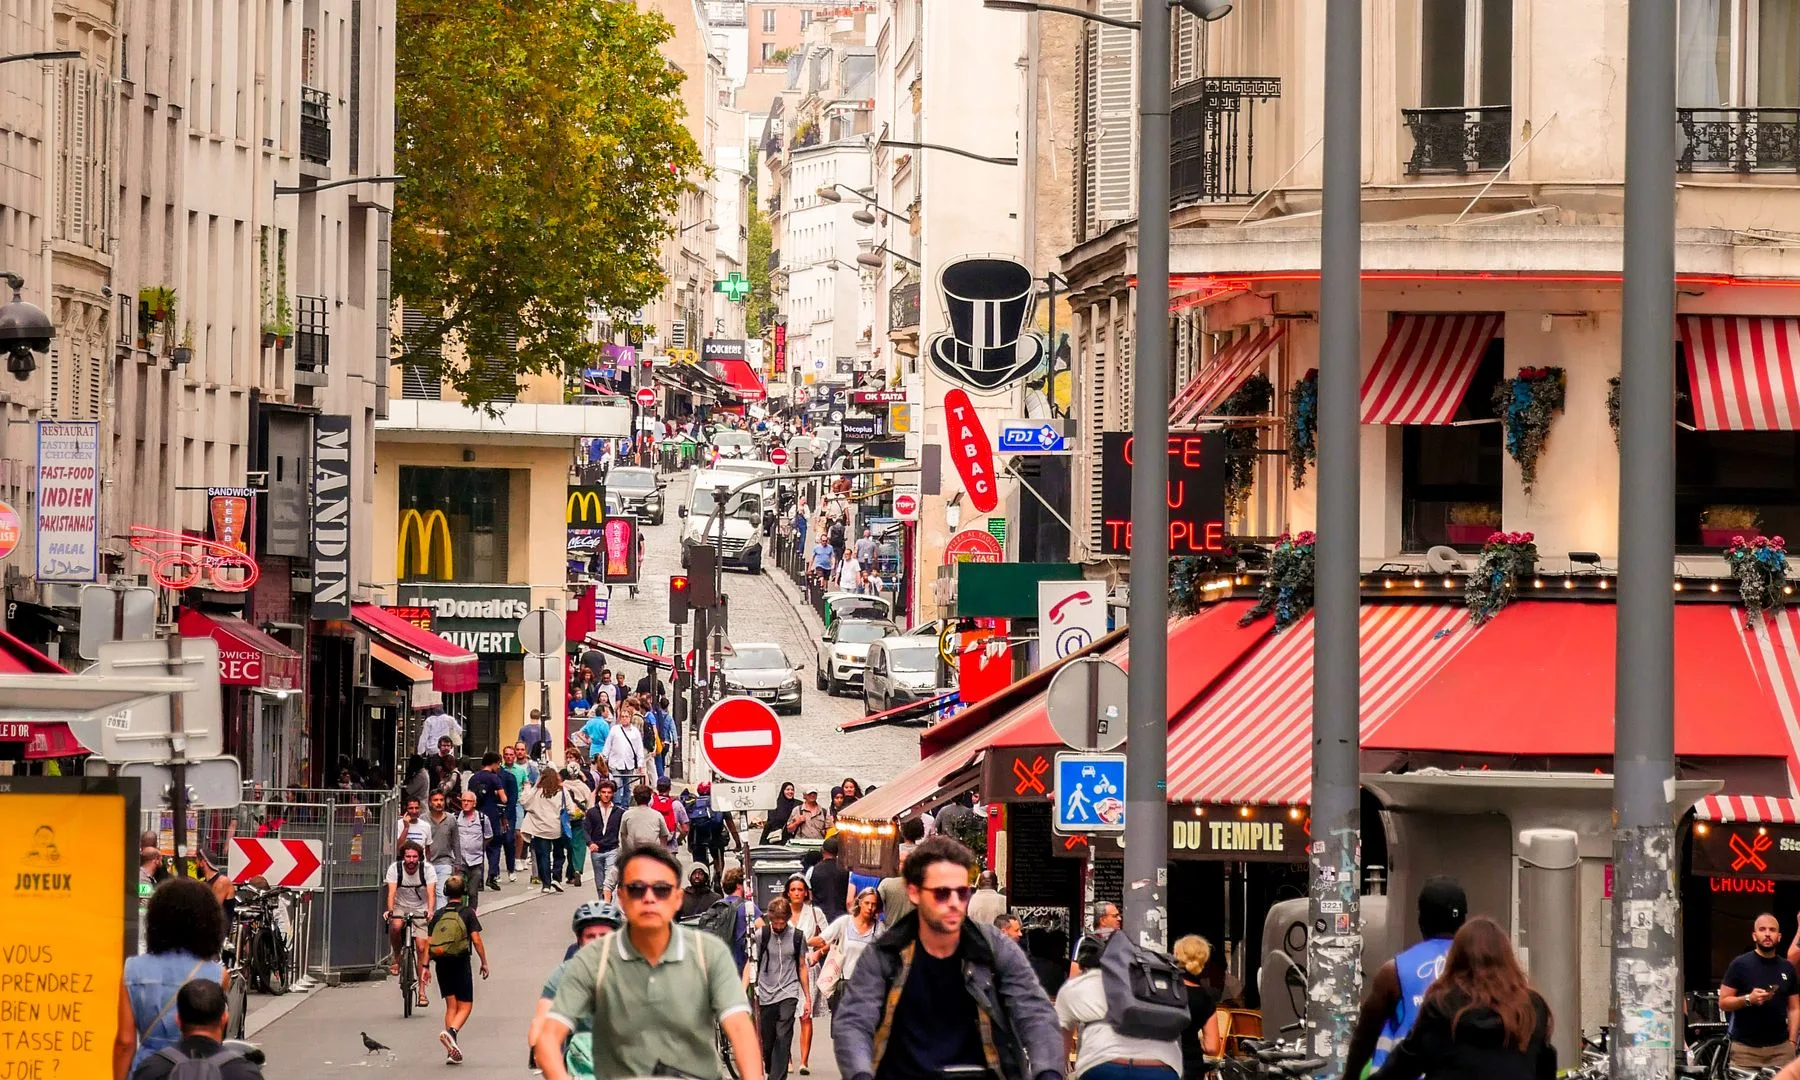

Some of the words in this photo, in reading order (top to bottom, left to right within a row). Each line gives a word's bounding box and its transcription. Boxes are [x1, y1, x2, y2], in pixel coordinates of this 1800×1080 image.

[42, 426, 95, 437] RESTAURAT
[1007, 430, 1033, 442] FDJ
[45, 451, 93, 459] CHICKEN
[953, 406, 988, 493] TABAC
[1125, 437, 1201, 468] CFE
[41, 466, 94, 480] FAST-FOOD
[41, 487, 93, 508] INDIEN
[208, 488, 256, 496] SANDWICH
[40, 515, 94, 532] PAKISTANAIS
[224, 499, 233, 541] KEBAB
[314, 428, 348, 607] MANDIN
[1106, 521, 1223, 550] TEPLE
[49, 543, 85, 554] HALAL
[387, 608, 431, 618] PIZZA
[439, 632, 514, 653] OUVERT
[11, 724, 29, 737] D'OR
[1173, 821, 1200, 849] DU
[1209, 821, 1284, 850] TEMPLE
[15, 873, 71, 891] JOYEUX
[3, 944, 53, 964] VOUS
[2, 972, 94, 993] PRENDREZ
[48, 1001, 82, 1022] UNE
[2, 1030, 64, 1052] TASSE
[72, 1031, 94, 1052] DE
